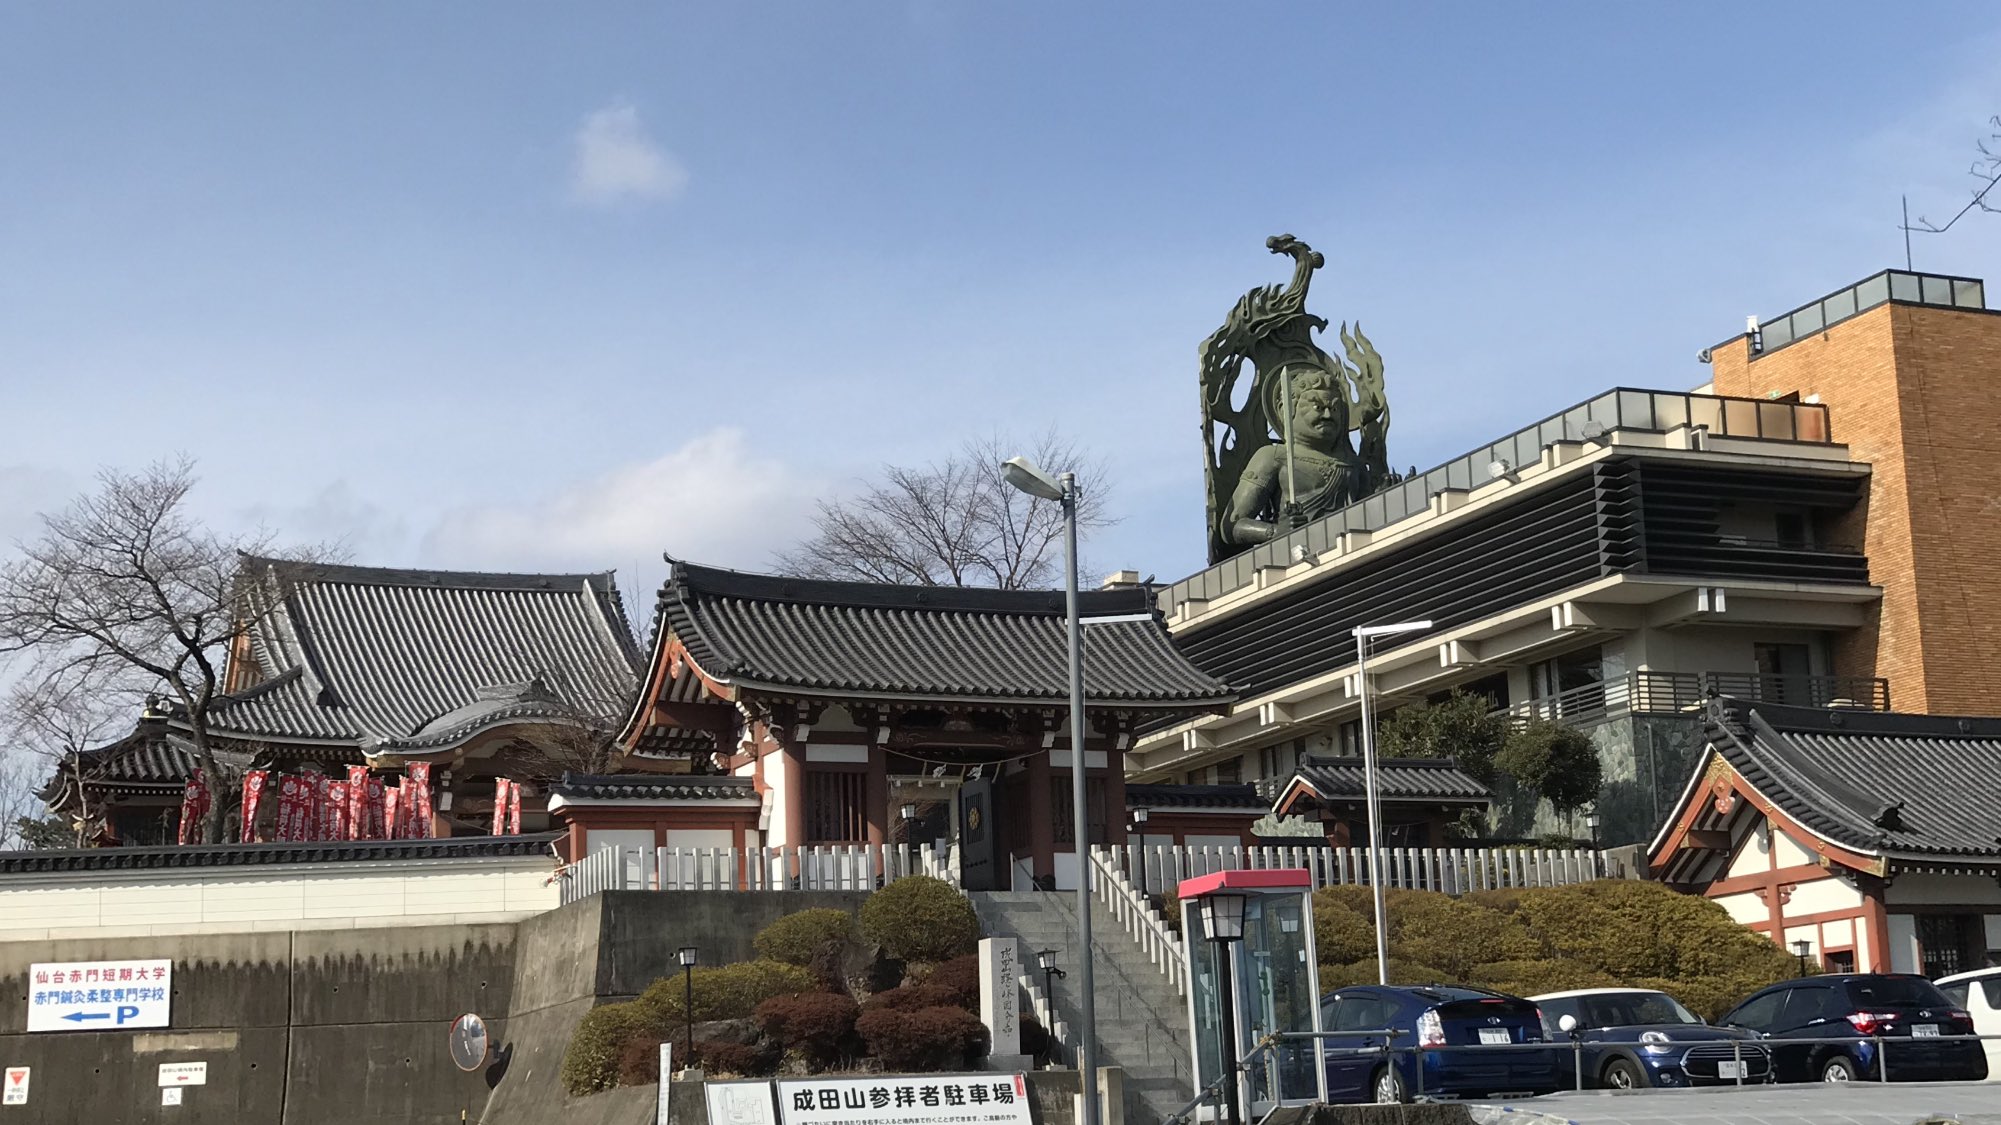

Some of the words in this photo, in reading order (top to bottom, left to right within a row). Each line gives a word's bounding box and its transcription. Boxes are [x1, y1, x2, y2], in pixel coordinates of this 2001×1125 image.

[35, 967, 166, 984] 仙台赤門短期大学
[34, 987, 165, 1005] 赤門鍼灸柔整専門学校
[116, 1005, 139, 1025] P
[793, 1083, 1014, 1111] 成田山参拝者駐車場
